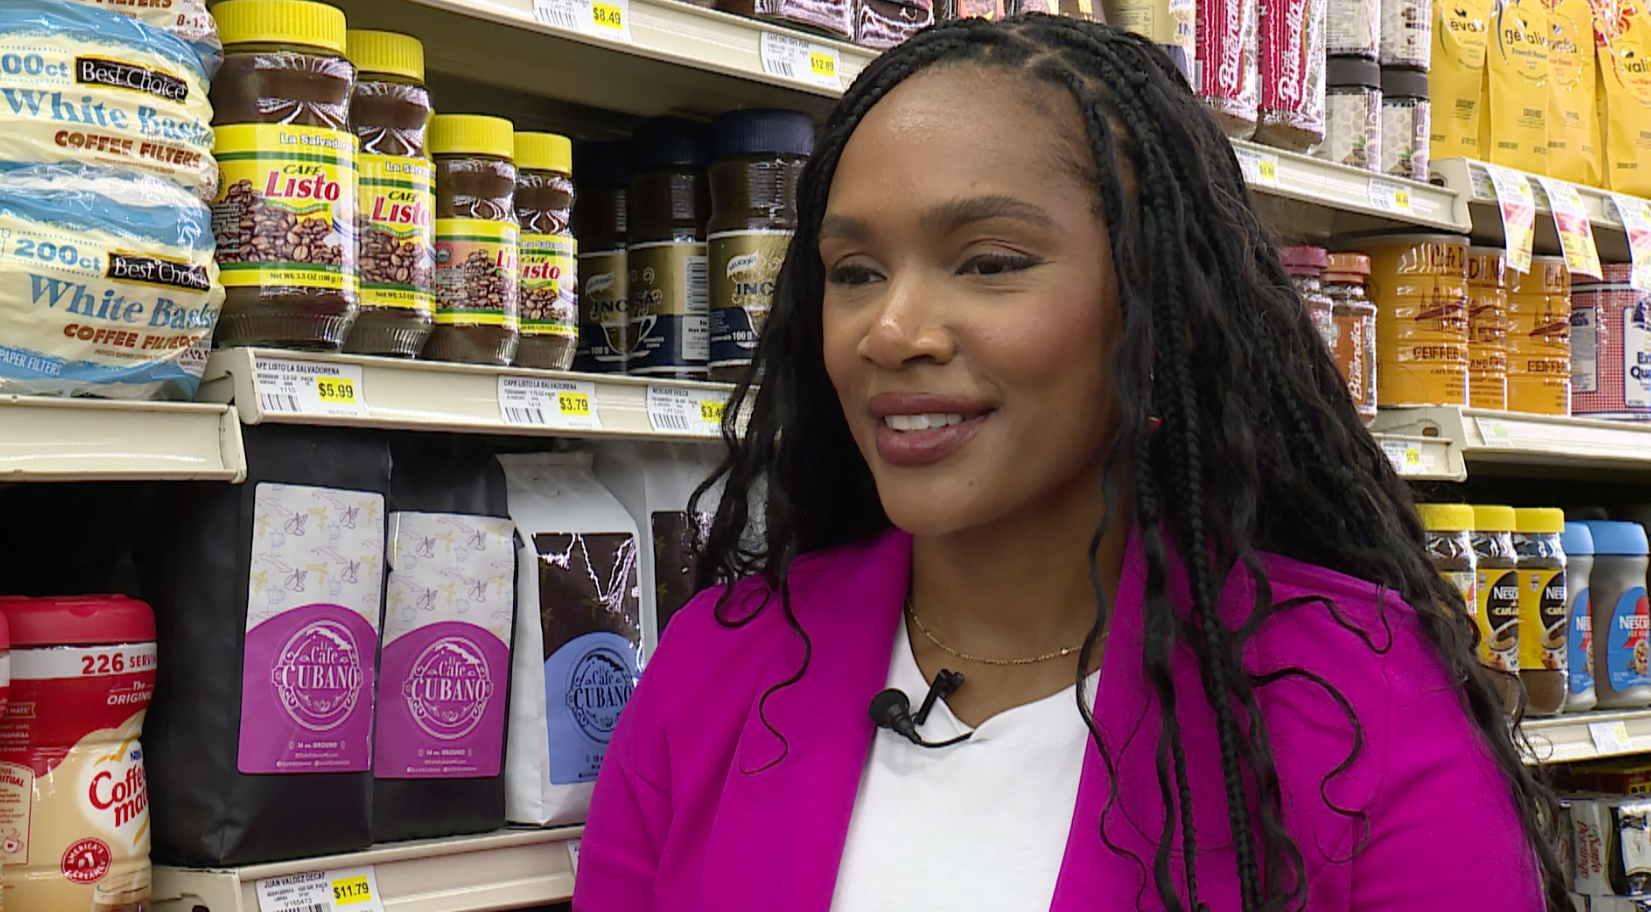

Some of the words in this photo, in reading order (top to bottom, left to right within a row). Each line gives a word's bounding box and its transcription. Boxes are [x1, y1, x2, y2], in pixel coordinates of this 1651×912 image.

[593, 7, 621, 26] $8.49
[0, 53, 69, 78] 00ct
[82, 61, 121, 85] Best
[127, 69, 187, 102] Choice
[0, 87, 129, 130] White
[55, 130, 133, 156] COFFEE
[280, 132, 297, 144] La
[140, 142, 201, 168] FILTERS
[264, 170, 341, 202] Listo
[372, 196, 431, 227] Listo
[14, 239, 101, 272] 200ct
[115, 257, 154, 280] Best
[522, 260, 561, 280] isto
[29, 274, 143, 324] White
[64, 324, 139, 348] COFFEE
[0, 350, 27, 369] PAPER
[27, 355, 63, 377] FILTERS
[268, 362, 286, 371] LISTO
[287, 364, 295, 372] LA
[318, 382, 353, 399] $5.99
[559, 396, 588, 411] $3.79
[81, 653, 124, 675] 226
[282, 665, 358, 689] CUBANO
[411, 677, 486, 701] CUBANO
[574, 686, 632, 709] CUBANO
[115, 786, 148, 828] mat
[264, 880, 280, 889] JUAN
[281, 874, 305, 886] VALDEZ
[333, 882, 369, 900] $11.79
